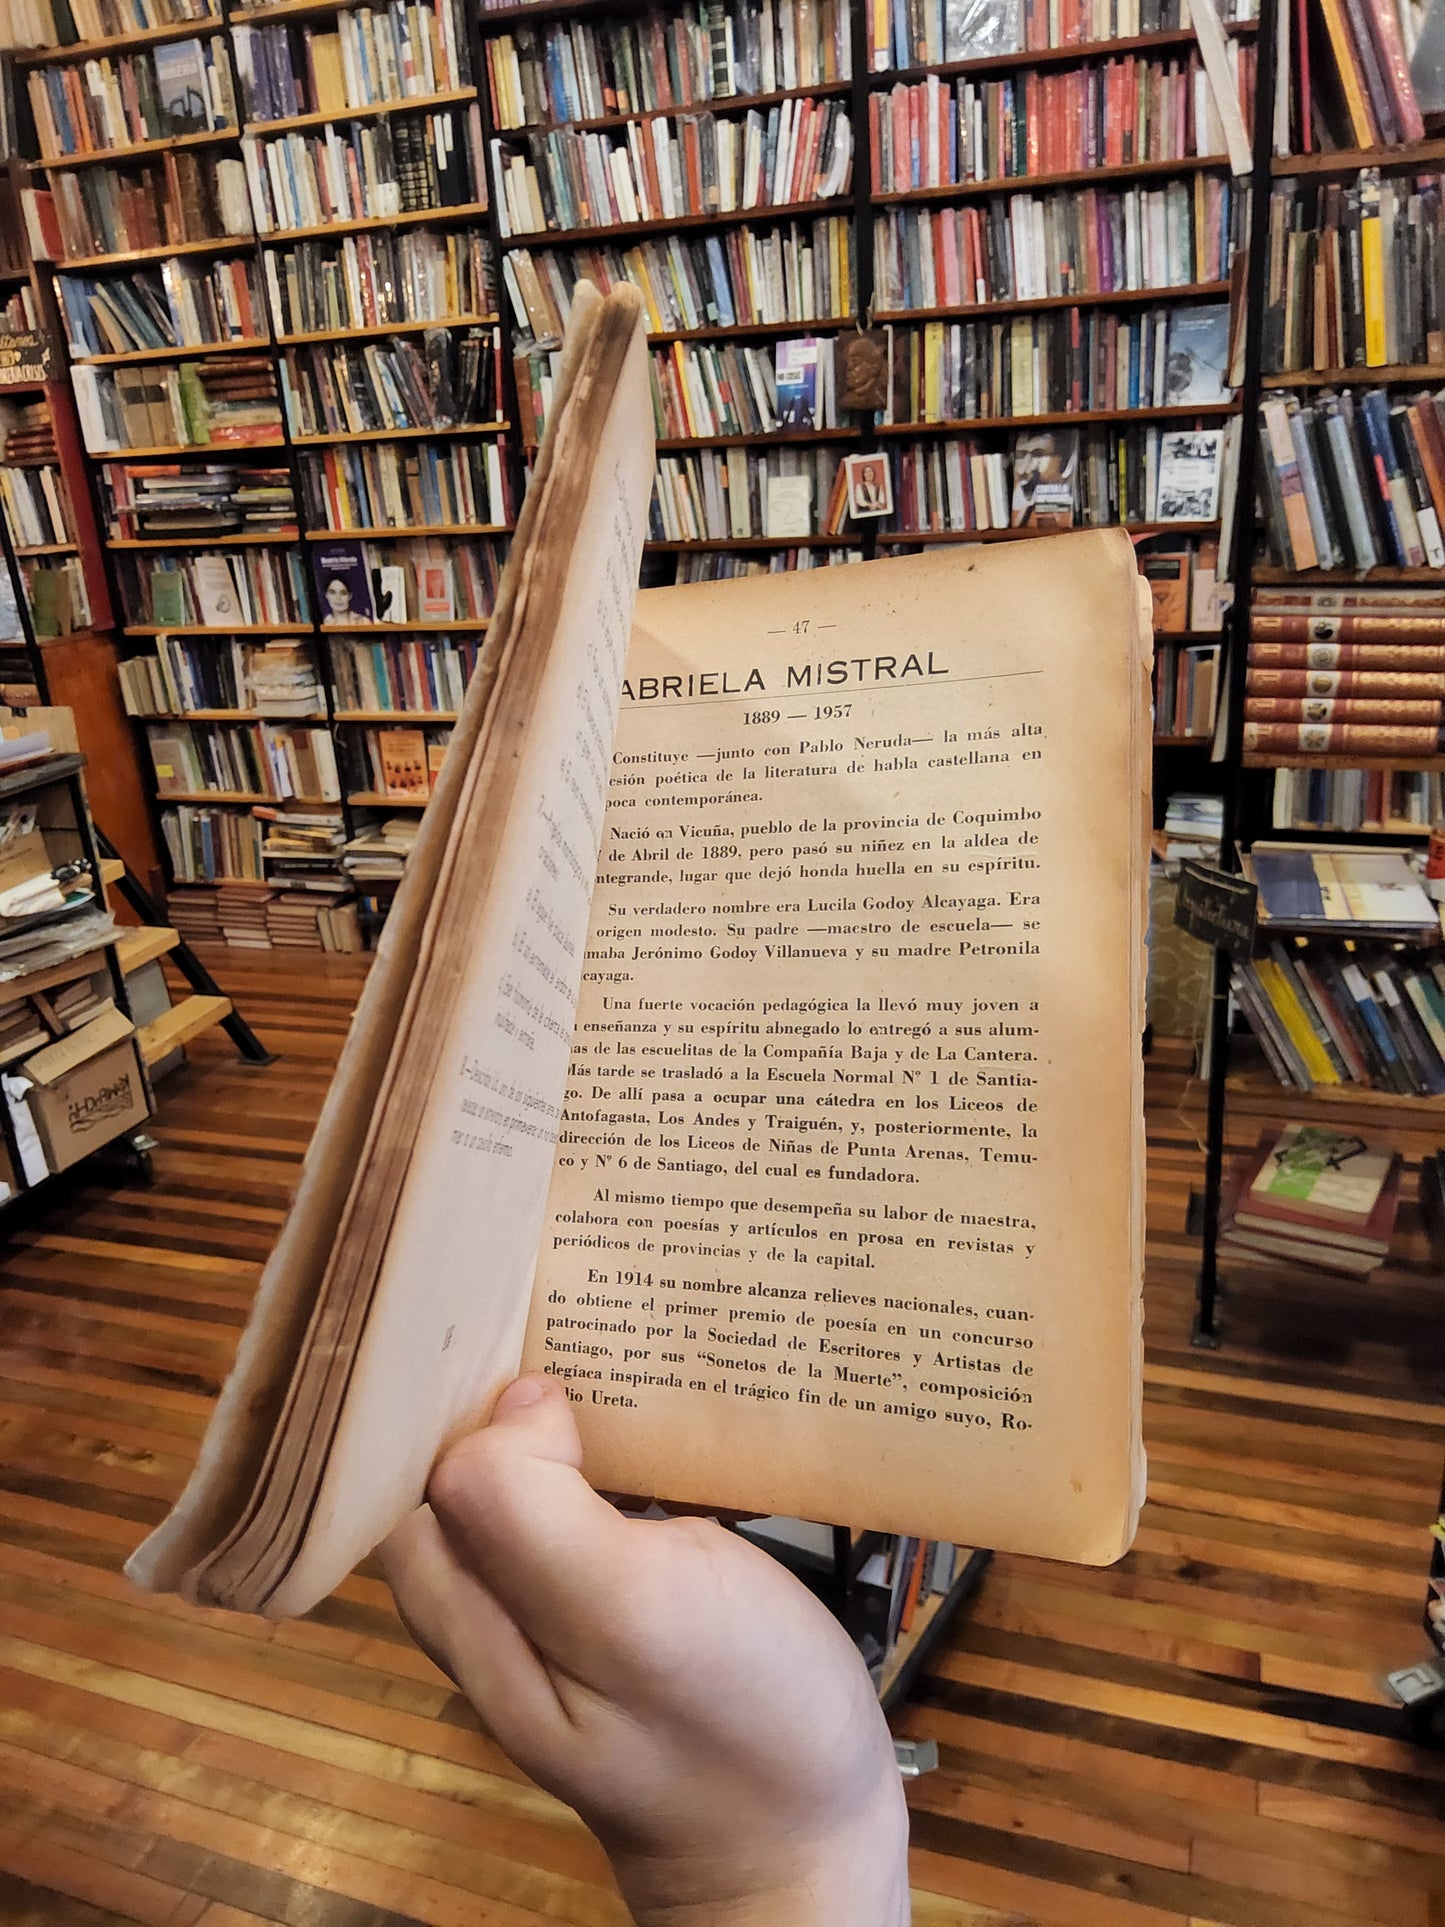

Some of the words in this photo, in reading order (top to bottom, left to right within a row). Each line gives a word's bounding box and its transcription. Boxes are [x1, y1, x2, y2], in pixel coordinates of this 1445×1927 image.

[791, 619, 811, 635] 47
[620, 667, 767, 702] ABRIELA
[787, 651, 949, 689] MISTRAL
[743, 709, 781, 726] 1889
[813, 703, 853, 721] 1957
[612, 750, 689, 766] Constituye
[764, 746, 790, 756] con
[799, 739, 844, 754] Pablo
[967, 726, 1000, 741] más
[1011, 722, 1042, 737] alta
[609, 773, 645, 787] esión
[655, 771, 708, 788] poética
[765, 765, 837, 779] literatura
[874, 756, 918, 772] habla
[927, 750, 1010, 768] castellana
[645, 790, 763, 809] contemporánea.
[610, 826, 650, 840] Nació
[679, 824, 735, 839] Vicuña,
[740, 820, 792, 839] pueblo
[843, 814, 919, 835] provincia
[952, 806, 1042, 827] Coquimbo
[631, 847, 669, 861] Abril
[702, 845, 742, 859] 1889,
[749, 847, 784, 861] pero
[792, 841, 828, 859] pasó
[861, 839, 905, 853] niñez
[964, 833, 1009, 848] aldea
[596, 870, 673, 887] ntegrande,
[679, 869, 718, 885] lugar
[725, 871, 752, 884] que
[758, 865, 792, 883] dejó
[799, 863, 848, 878] honda
[856, 861, 905, 876] huella
[968, 856, 1041, 875] espíritu.
[633, 901, 706, 916] verdadero
[712, 900, 771, 914] nombre
[776, 903, 800, 913] era
[807, 897, 856, 912] Lucila
[862, 896, 915, 913] Godoy
[921, 894, 1001, 912] Alcayaga.
[1009, 891, 1040, 906] Era
[596, 925, 642, 941] origen
[650, 924, 717, 937] modesto.
[754, 922, 799, 940] padre
[583, 946, 625, 960] maba
[631, 946, 703, 961] Jerónimo
[710, 945, 757, 963] Godoy
[764, 944, 847, 958] Villanueva
[898, 942, 951, 957] madre
[959, 940, 1040, 956] Petronila
[580, 972, 634, 985] cayaga.
[603, 997, 631, 1010] Una
[638, 997, 683, 1011] fuerte
[690, 998, 755, 1011] vocación
[762, 997, 849, 1015] pedagógica
[878, 997, 917, 1011] llevó
[926, 1002, 963, 1015] muy
[971, 998, 1019, 1016] joven
[583, 1020, 657, 1033] enseñanza
[700, 1021, 760, 1038] espíritu
[765, 1021, 840, 1039] abnegado
[869, 1022, 932, 1040] entregó
[955, 1026, 982, 1036] sus
[988, 1021, 1039, 1036] alum-
[616, 1041, 637, 1056] las
[641, 1042, 713, 1057] escuelitas
[763, 1044, 843, 1062] Compañía
[851, 1045, 888, 1063] Baja
[964, 1046, 1038, 1062] Cantera.
[597, 1064, 635, 1078] tarde
[662, 1065, 723, 1080] trasladó
[767, 1067, 826, 1082] Escuela
[832, 1069, 894, 1084] Normal
[976, 1071, 1038, 1087] Santia-
[618, 1086, 643, 1101] allí
[651, 1092, 685, 1105] pasa
[713, 1093, 767, 1108] ocupar
[775, 1095, 805, 1106] una
[816, 1092, 875, 1108] cátedra
[915, 1094, 939, 1110] los
[949, 1095, 1004, 1112] Liceos
[560, 1108, 651, 1126] Antofagasta,
[658, 1110, 685, 1125] Los
[692, 1112, 740, 1127] Andes
[764, 1114, 843, 1134] Traiguén,
[874, 1120, 1011, 1138] posteriormente,
[559, 1130, 626, 1146] dirección
[659, 1133, 680, 1148] los
[687, 1135, 735, 1151] Liceos
[769, 1138, 813, 1154] Niñas
[847, 1141, 896, 1158] Punta
[905, 1144, 969, 1161] Arenas,
[979, 1147, 1038, 1164] Temu-
[657, 1156, 728, 1177] Santiago,
[734, 1160, 758, 1175] del
[765, 1163, 798, 1177] cual
[827, 1165, 920, 1183] fundadora.
[593, 1188, 609, 1202] Al
[615, 1190, 665, 1205] mismo
[671, 1193, 724, 1212] tiempo
[730, 1200, 758, 1214] que
[763, 1197, 852, 1219] desempeña
[883, 1204, 928, 1221] labor
[960, 1214, 1036, 1230] maestra,
[555, 1210, 618, 1226] colabora
[626, 1218, 653, 1228] con
[663, 1218, 720, 1233] poesías
[748, 1222, 818, 1239] artículos
[857, 1232, 904, 1247] prosa
[948, 1237, 1014, 1254] revistas
[552, 1234, 630, 1251] periódicos
[662, 1242, 741, 1259] provincias
[816, 1252, 875, 1270] capital.
[587, 1268, 608, 1284] En
[615, 1270, 654, 1287] 1914
[682, 1278, 742, 1295] nombre
[747, 1281, 807, 1300] alcanza
[814, 1287, 877, 1307] relieves
[884, 1296, 979, 1320] nacionales,
[986, 1308, 1034, 1322] cuan-
[576, 1292, 632, 1309] obtiene
[665, 1300, 718, 1317] primer
[729, 1309, 786, 1323] premio
[825, 1317, 877, 1333] poesía
[952, 1332, 1034, 1349] concurso
[546, 1317, 637, 1334] patrocinado
[646, 1326, 674, 1340] por
[707, 1327, 777, 1348] Sociedad
[819, 1338, 901, 1362] Escritores
[932, 1351, 1001, 1373] Artistas
[544, 1336, 613, 1359] Santiago,
[623, 1348, 651, 1362] por
[661, 1352, 685, 1364] sus
[919, 1382, 1032, 1404] composición
[543, 1361, 602, 1381] elegíaca
[610, 1368, 683, 1388] inspirada
[734, 1383, 790, 1402] trágico
[798, 1387, 821, 1404] fin
[883, 1402, 937, 1423] amigo
[944, 1411, 991, 1428] suyo,
[1001, 1412, 1032, 1430] Ro-
[591, 1389, 638, 1408] Ureta.
